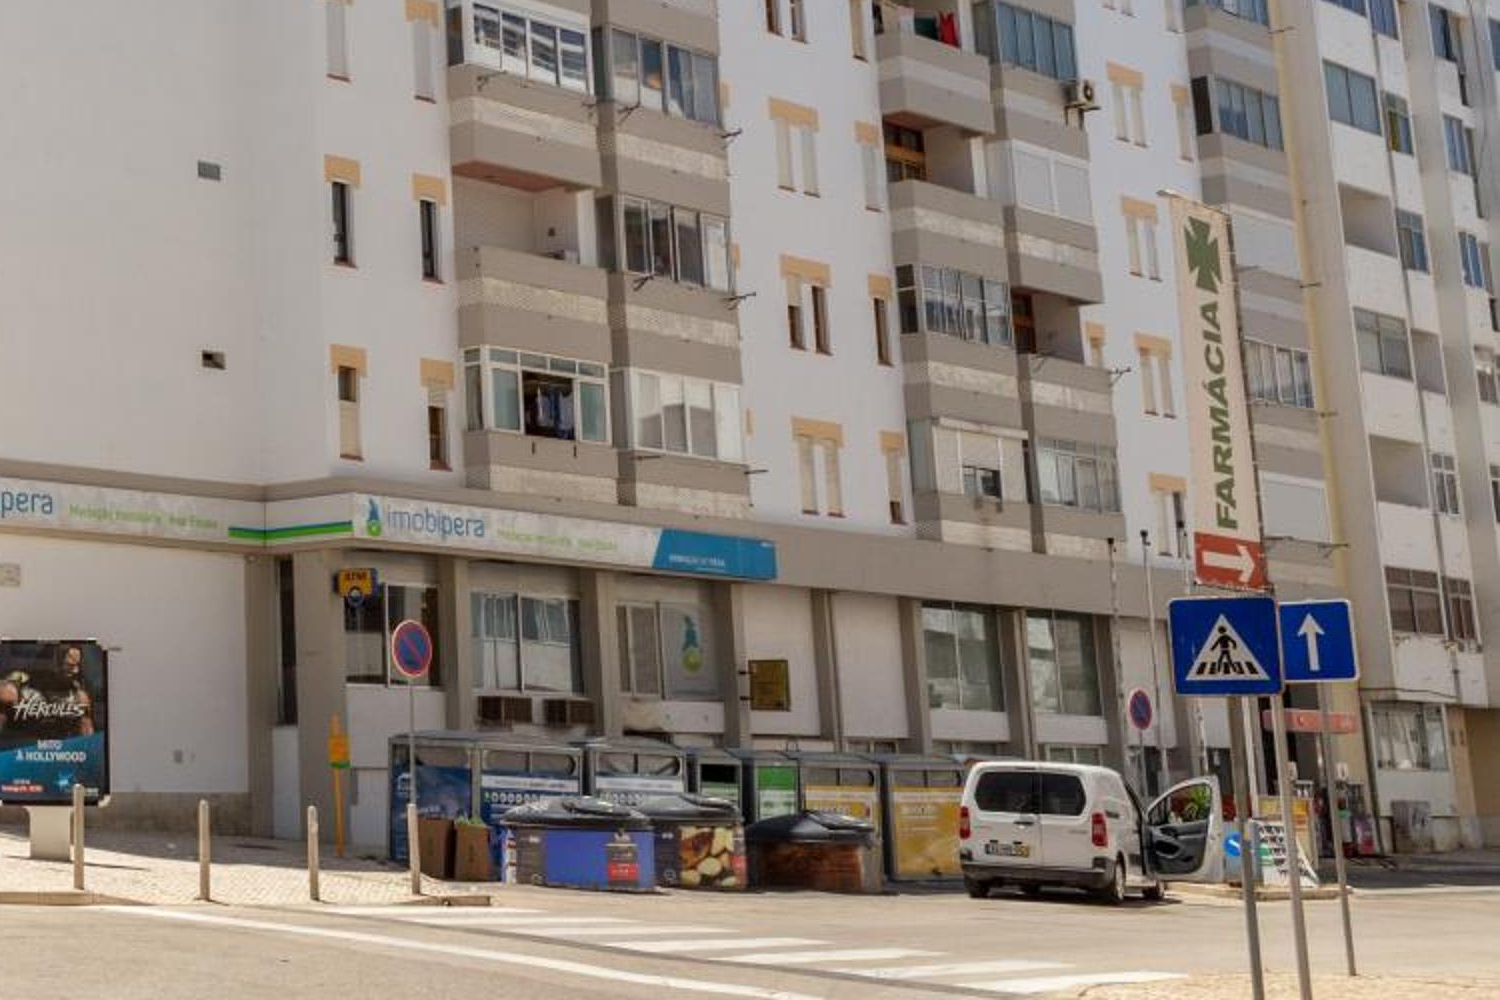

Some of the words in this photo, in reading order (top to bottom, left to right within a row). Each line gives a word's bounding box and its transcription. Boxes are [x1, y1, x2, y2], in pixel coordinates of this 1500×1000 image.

[1201, 301, 1238, 530] FARMÁCIA
[387, 505, 485, 540] imobipera
[12, 697, 90, 720] HERCULES
[25, 751, 87, 762] HOLLYWOOD
